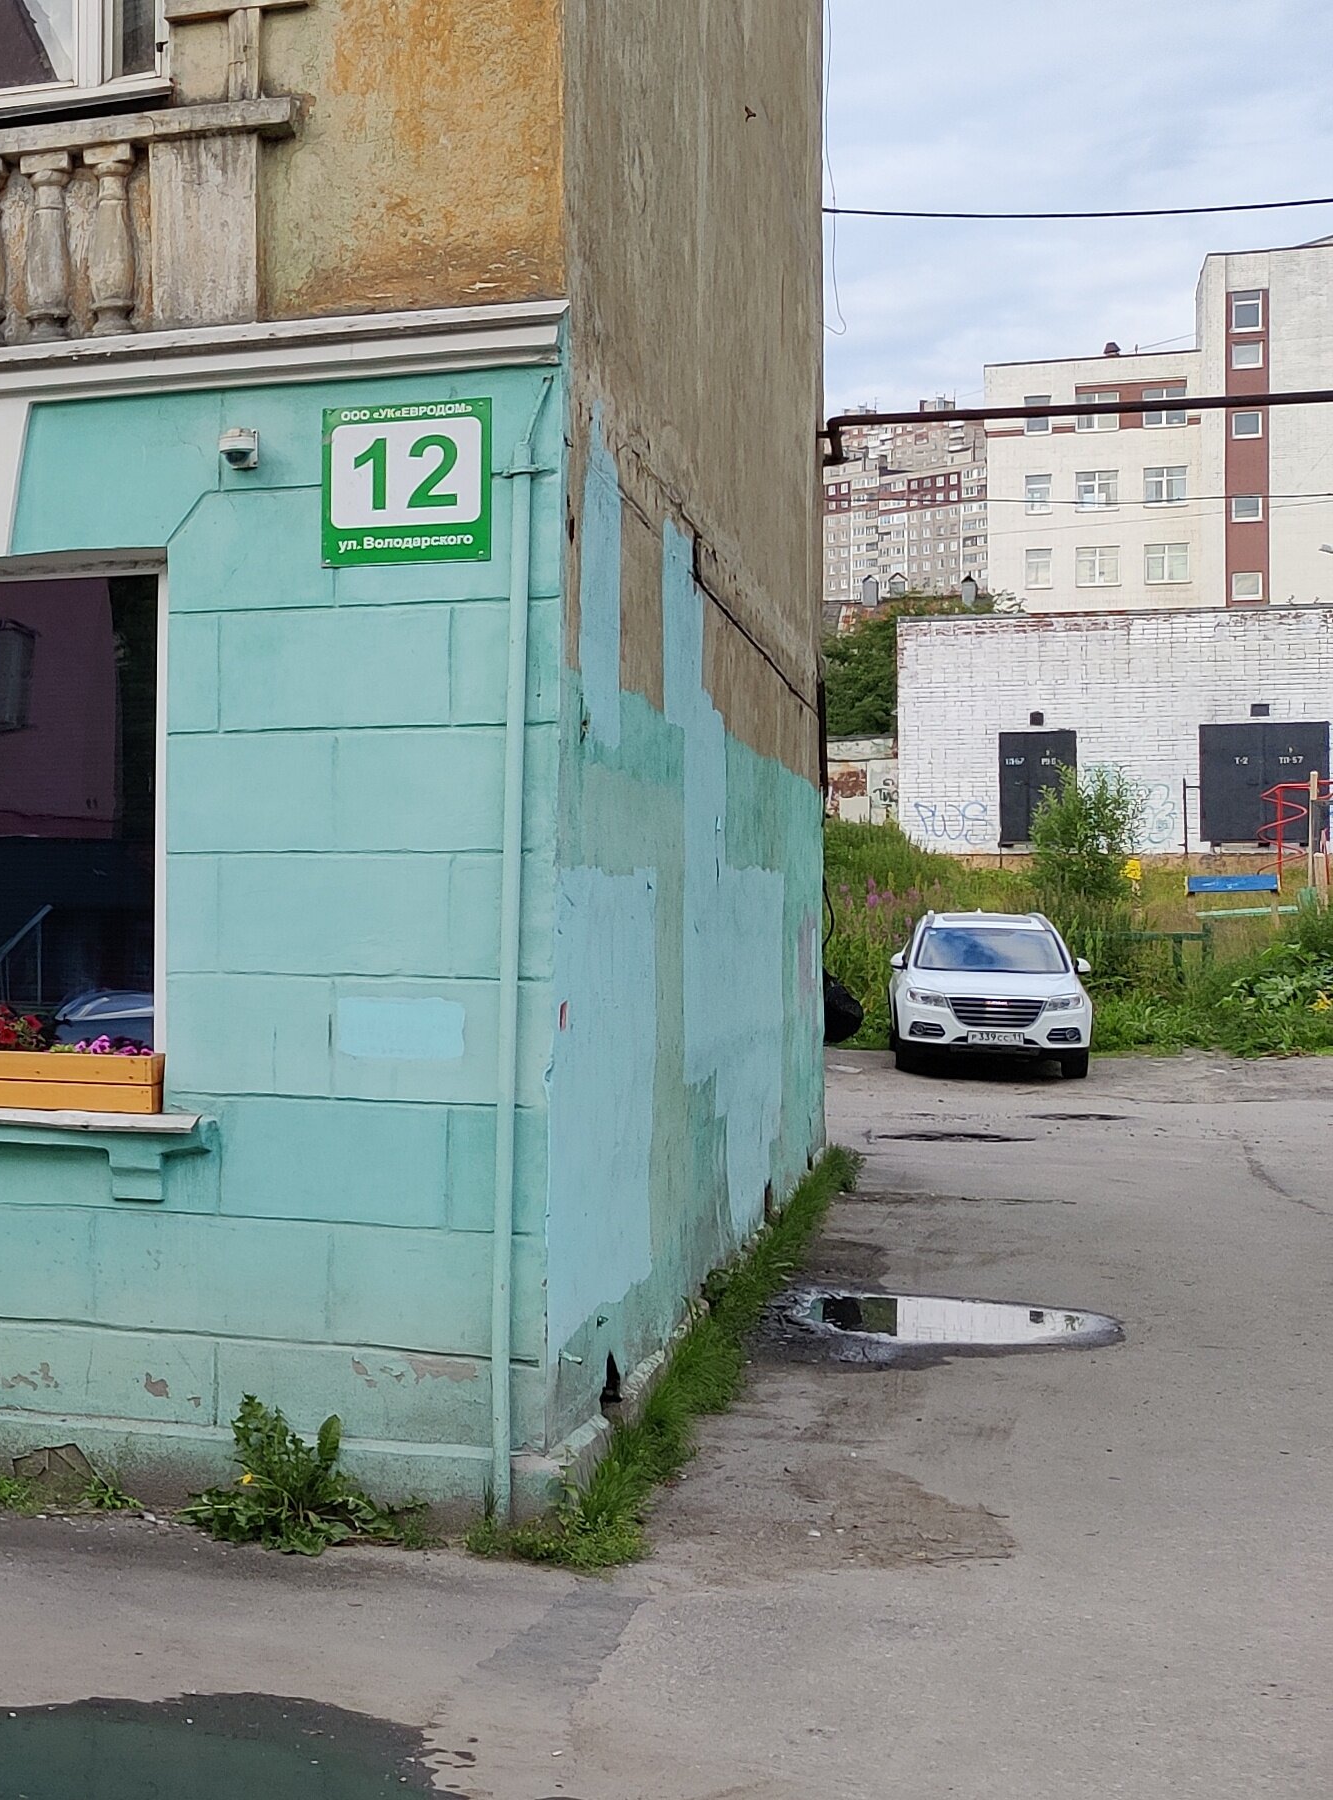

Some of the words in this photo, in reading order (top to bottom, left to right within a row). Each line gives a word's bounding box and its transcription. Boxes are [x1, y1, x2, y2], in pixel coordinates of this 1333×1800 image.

[341, 410, 370, 421] ООО
[354, 434, 458, 510] 12
[338, 541, 362, 554] ул.
[363, 534, 473, 551] Володарского
